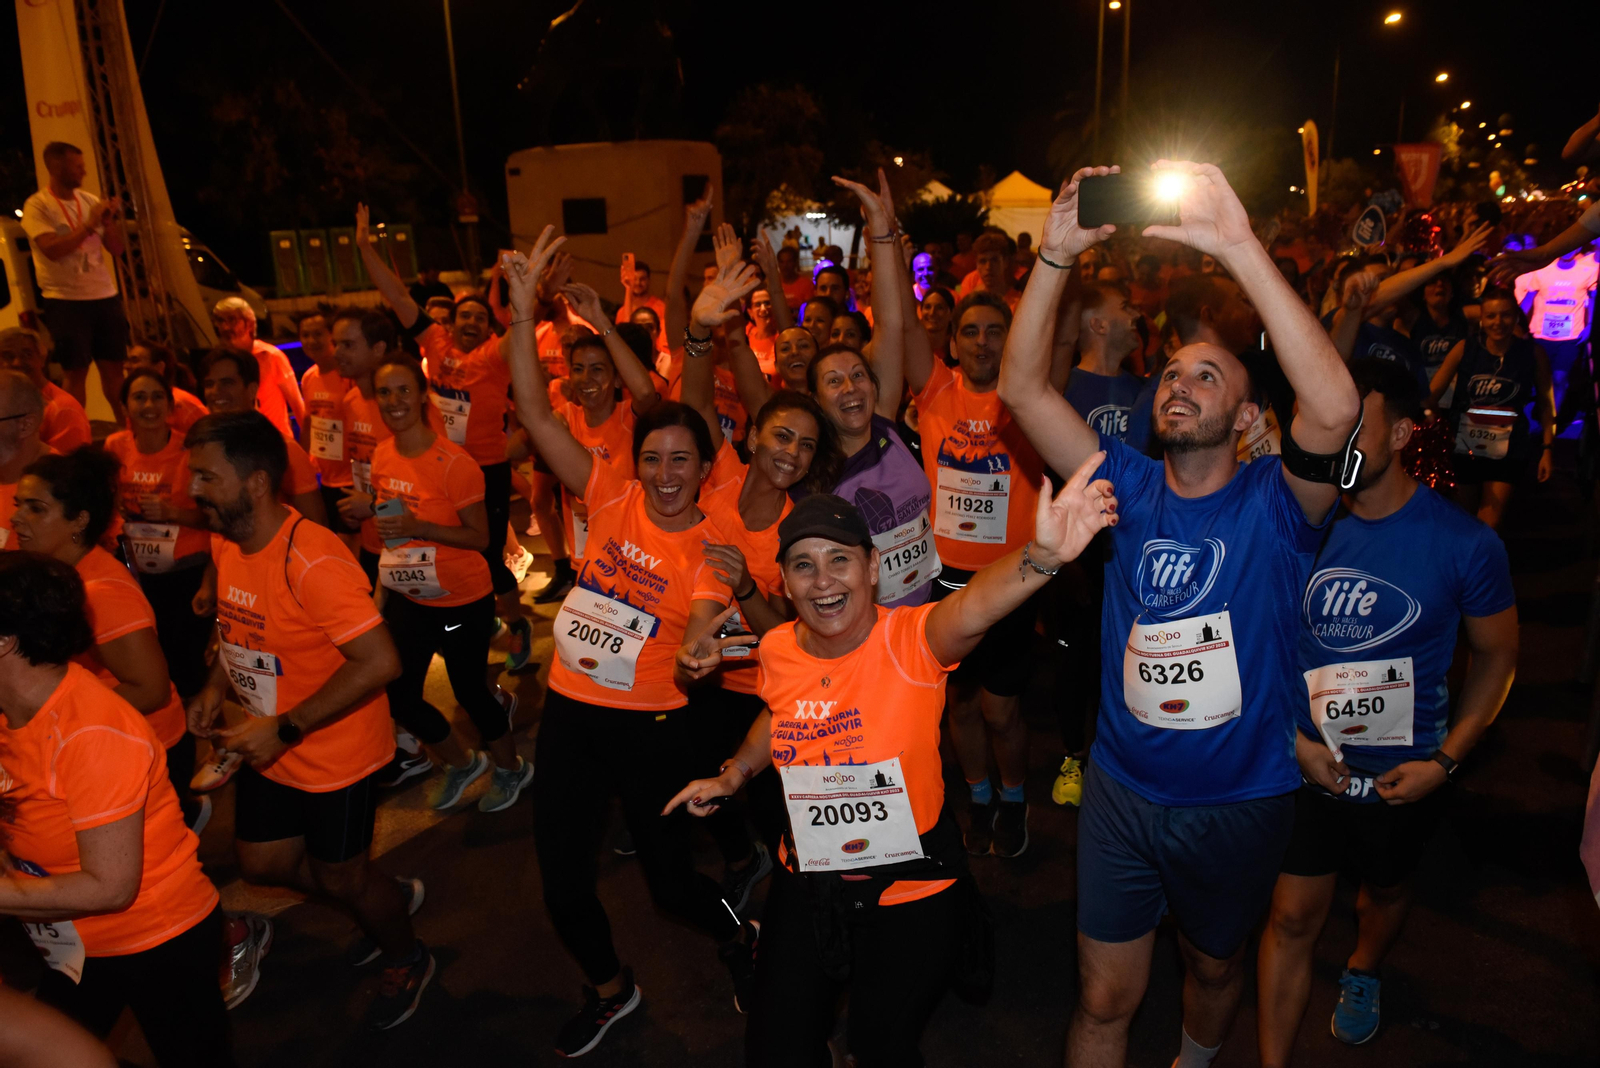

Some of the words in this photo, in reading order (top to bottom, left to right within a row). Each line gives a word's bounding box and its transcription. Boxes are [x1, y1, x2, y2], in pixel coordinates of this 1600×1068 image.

[1475, 379, 1502, 396] life
[1469, 429, 1497, 441] 6329
[948, 495, 993, 514] 11928
[134, 543, 160, 555] 7704
[621, 540, 663, 570] XXXV
[884, 539, 928, 572] 11930
[389, 570, 426, 582] 12343
[227, 585, 257, 608] XXXV
[1145, 581, 1200, 608] CARREFOUR
[1322, 580, 1378, 616] life
[567, 619, 624, 654] 20078
[1315, 623, 1374, 639] CARREFOUR
[1138, 660, 1204, 685] 6326
[794, 700, 838, 720] XXX
[1325, 696, 1385, 720] 6450
[777, 718, 863, 742] GUADALQUIVIR
[808, 801, 888, 826] 20093
[884, 850, 917, 859] Cruzcampo
